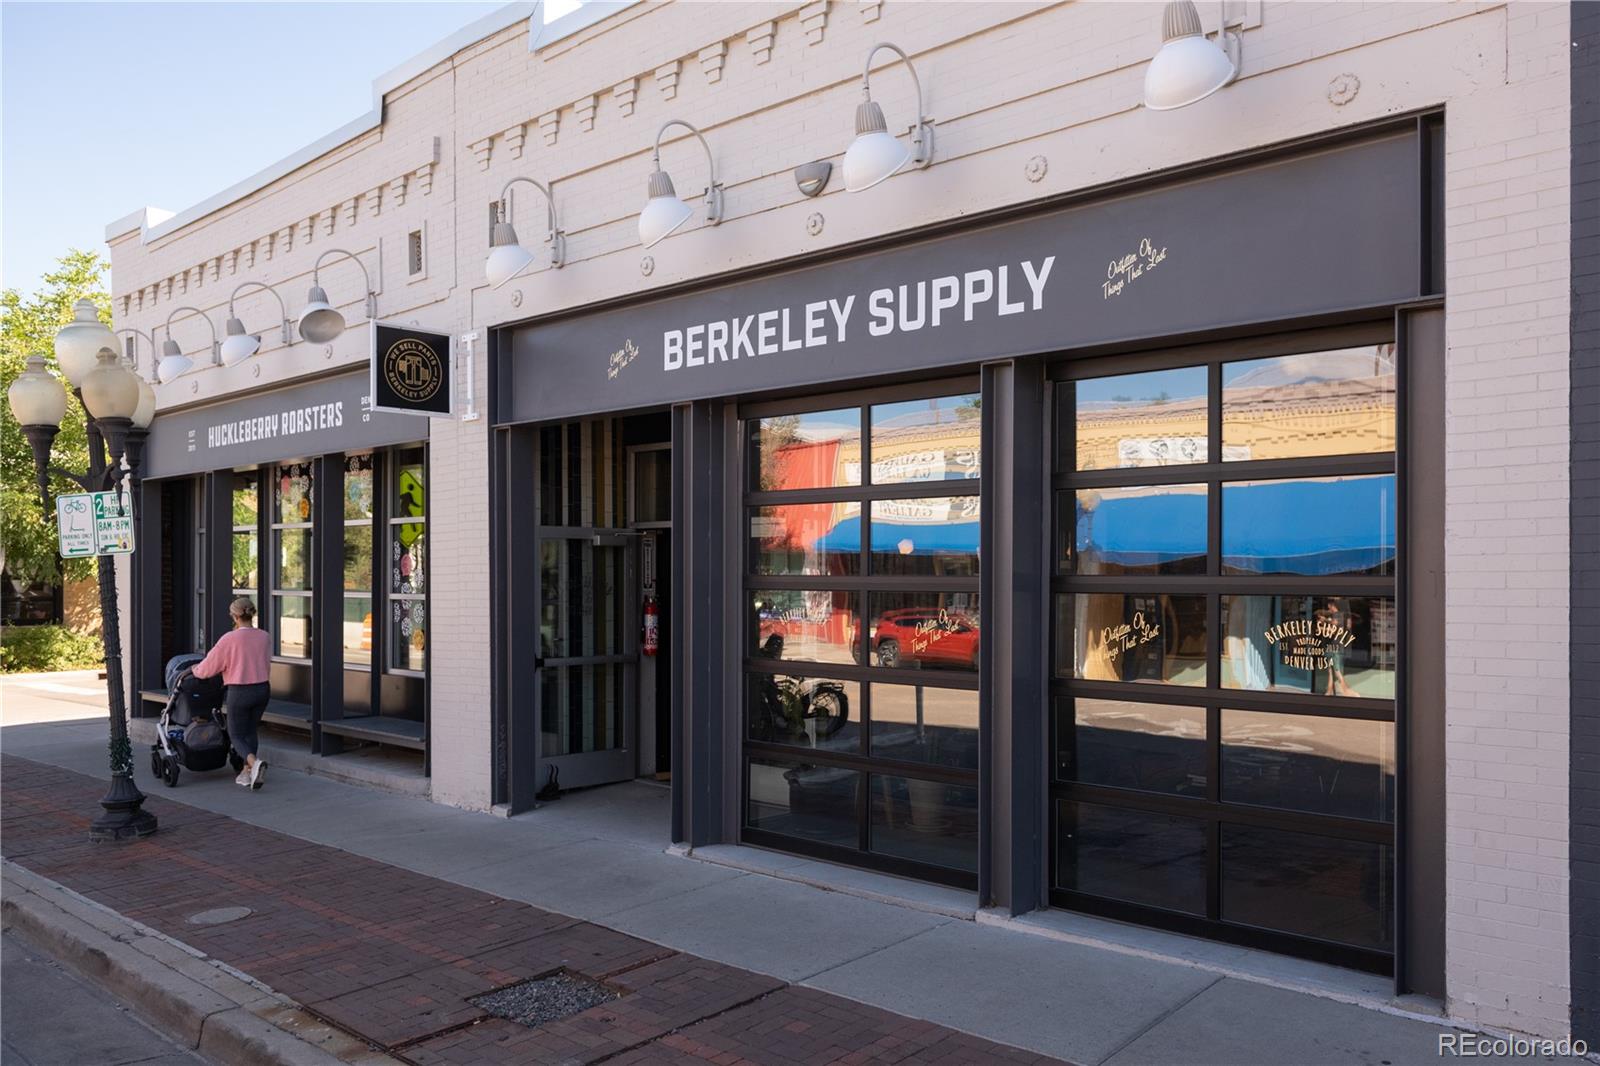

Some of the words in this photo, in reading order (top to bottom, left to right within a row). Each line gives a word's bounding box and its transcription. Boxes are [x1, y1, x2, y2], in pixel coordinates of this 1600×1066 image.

[663, 295, 856, 371] BERKELEY
[868, 256, 1056, 337] SUPPLY
[390, 349, 400, 360] WE
[399, 342, 417, 351] SELL
[418, 344, 437, 365] PANTS
[389, 372, 418, 398] BERKELEY
[420, 377, 438, 398] SUPPLY
[208, 418, 280, 449] HUCKLEBERRY
[281, 401, 343, 436] ROASTERS
[96, 498, 104, 515] 2
[1264, 619, 1313, 645] BERKELEY
[1315, 620, 1357, 648] SUPPLY
[1284, 655, 1315, 671] DENVER
[1317, 656, 1335, 670] USA
[1307, 647, 1325, 656] GOODS
